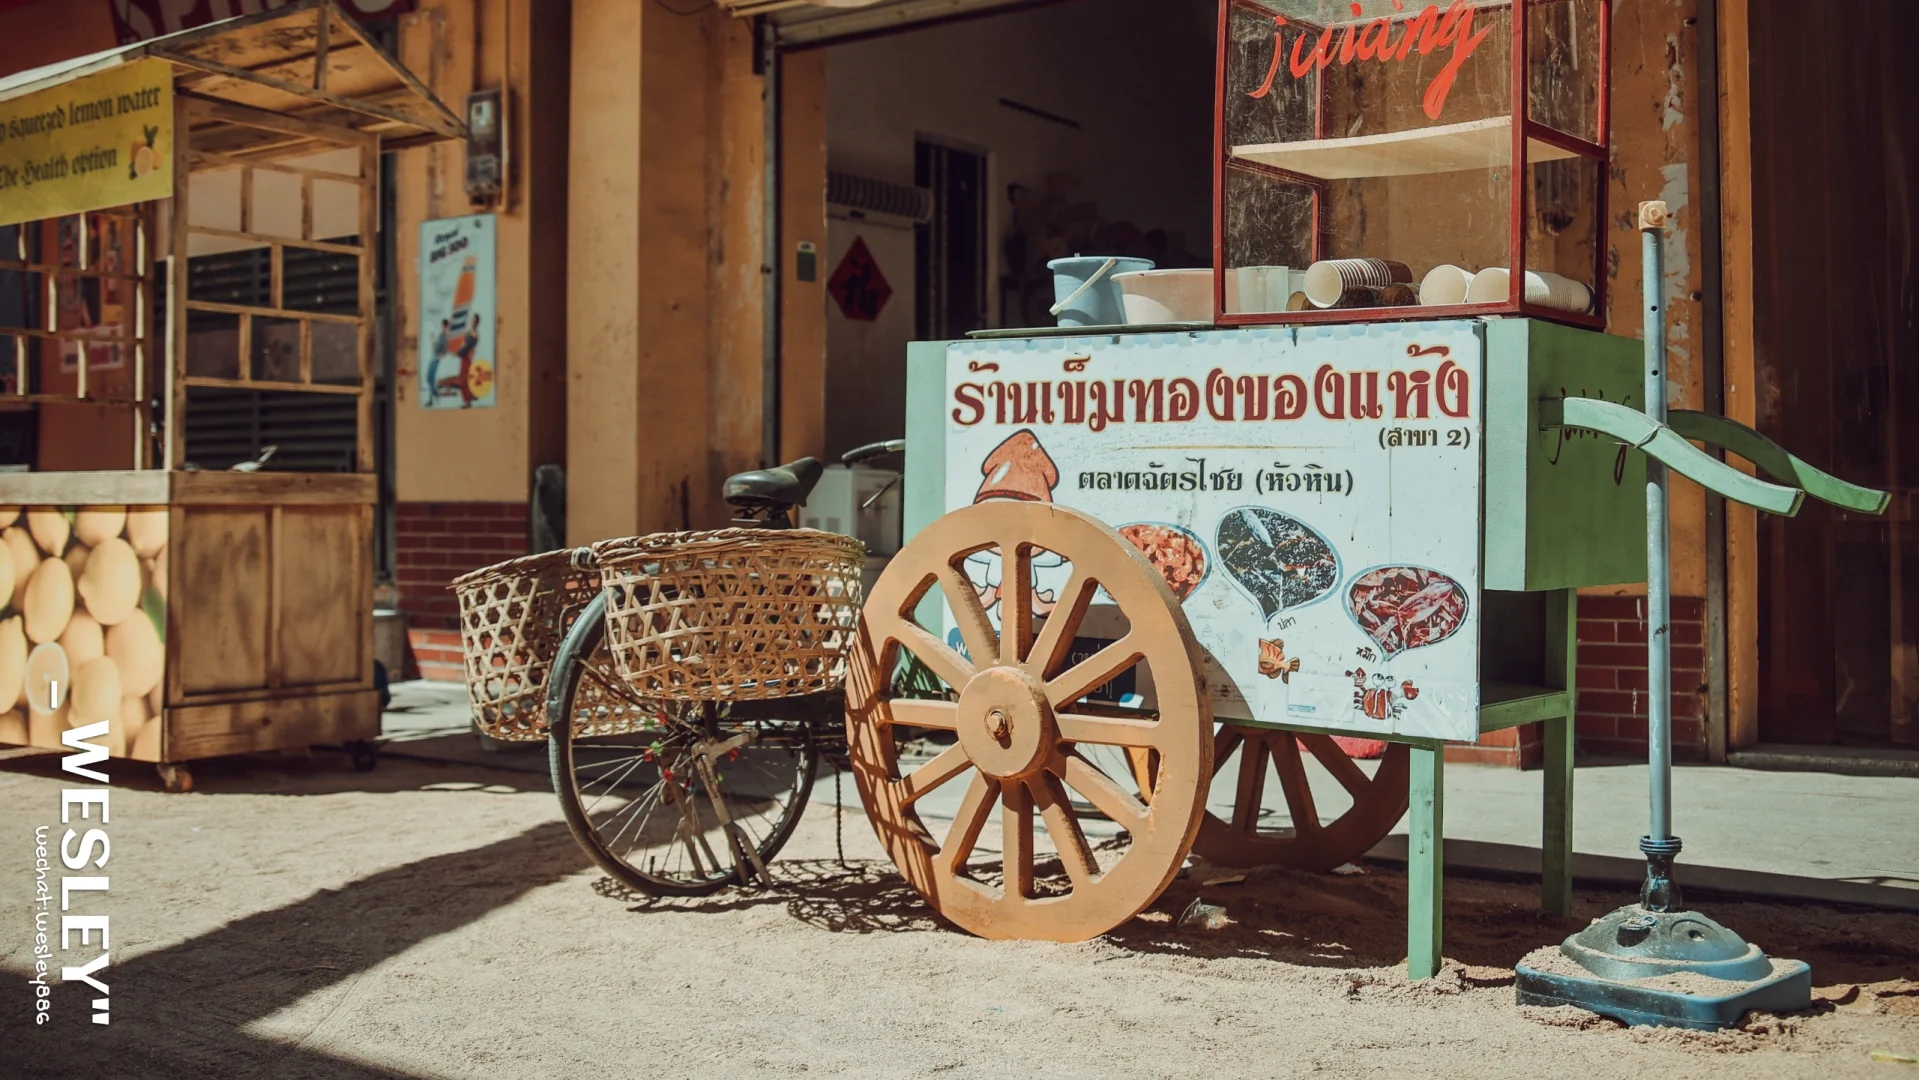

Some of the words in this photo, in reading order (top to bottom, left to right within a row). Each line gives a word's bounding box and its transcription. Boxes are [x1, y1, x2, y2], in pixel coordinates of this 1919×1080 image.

[9, 104, 65, 140] squeezed
[69, 97, 113, 126] lemon
[117, 87, 160, 115] water
[21, 156, 68, 186] Health
[72, 146, 117, 177] option
[952, 344, 1470, 432] ร้านเข็มทองของแห้ง
[1446, 427, 1471, 450] 2)
[1255, 461, 1354, 496] (หัวหิน)
